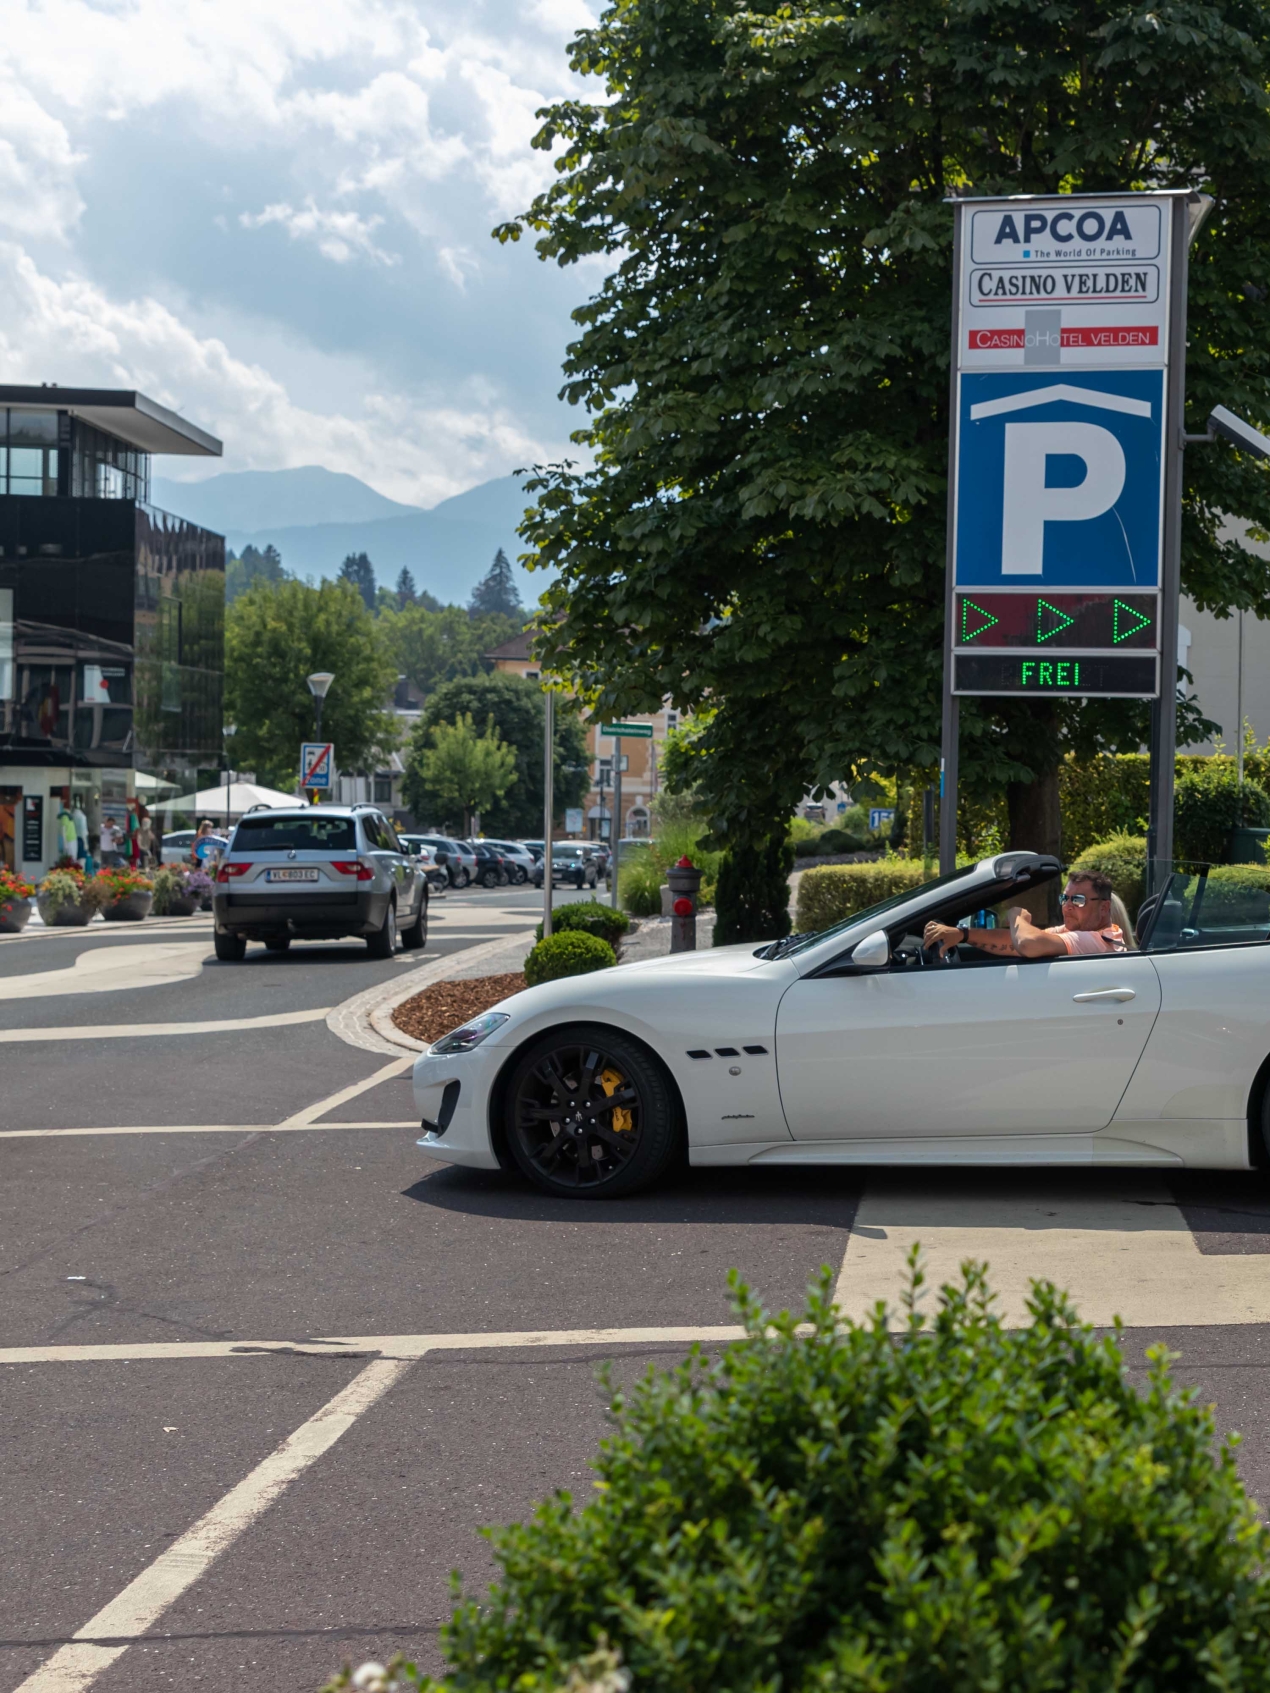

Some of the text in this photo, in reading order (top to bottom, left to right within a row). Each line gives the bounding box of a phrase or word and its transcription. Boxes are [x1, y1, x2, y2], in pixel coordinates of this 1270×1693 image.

[994, 210, 1133, 245] APCOA
[1034, 247, 1137, 258] The World Of Parking
[978, 272, 1148, 296] CASINO VELDEN
[1091, 332, 1150, 345] VELDEN
[1001, 421, 1126, 575] P
[1022, 662, 1079, 685] FREI
